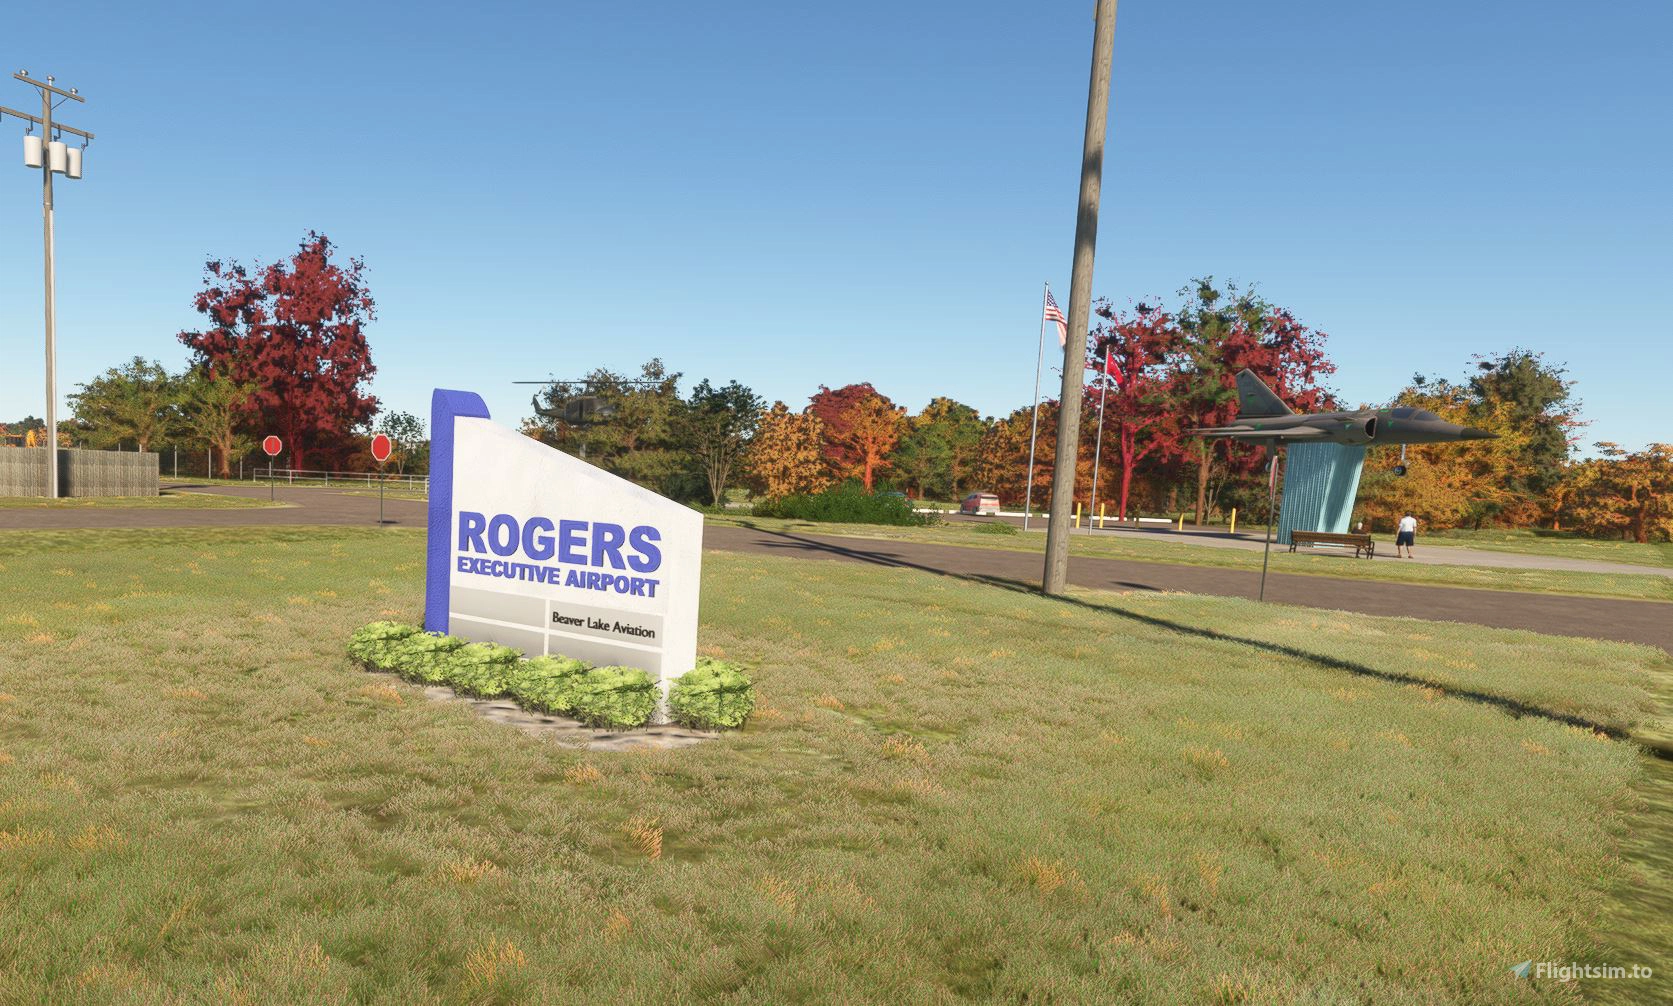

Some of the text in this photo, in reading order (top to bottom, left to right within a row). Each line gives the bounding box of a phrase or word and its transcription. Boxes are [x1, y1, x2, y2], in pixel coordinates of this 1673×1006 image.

[458, 511, 661, 573] ROGERS
[457, 556, 660, 598] EXECUTIVE AIRPORT
[552, 611, 655, 639] Beaver Lake Aviation
